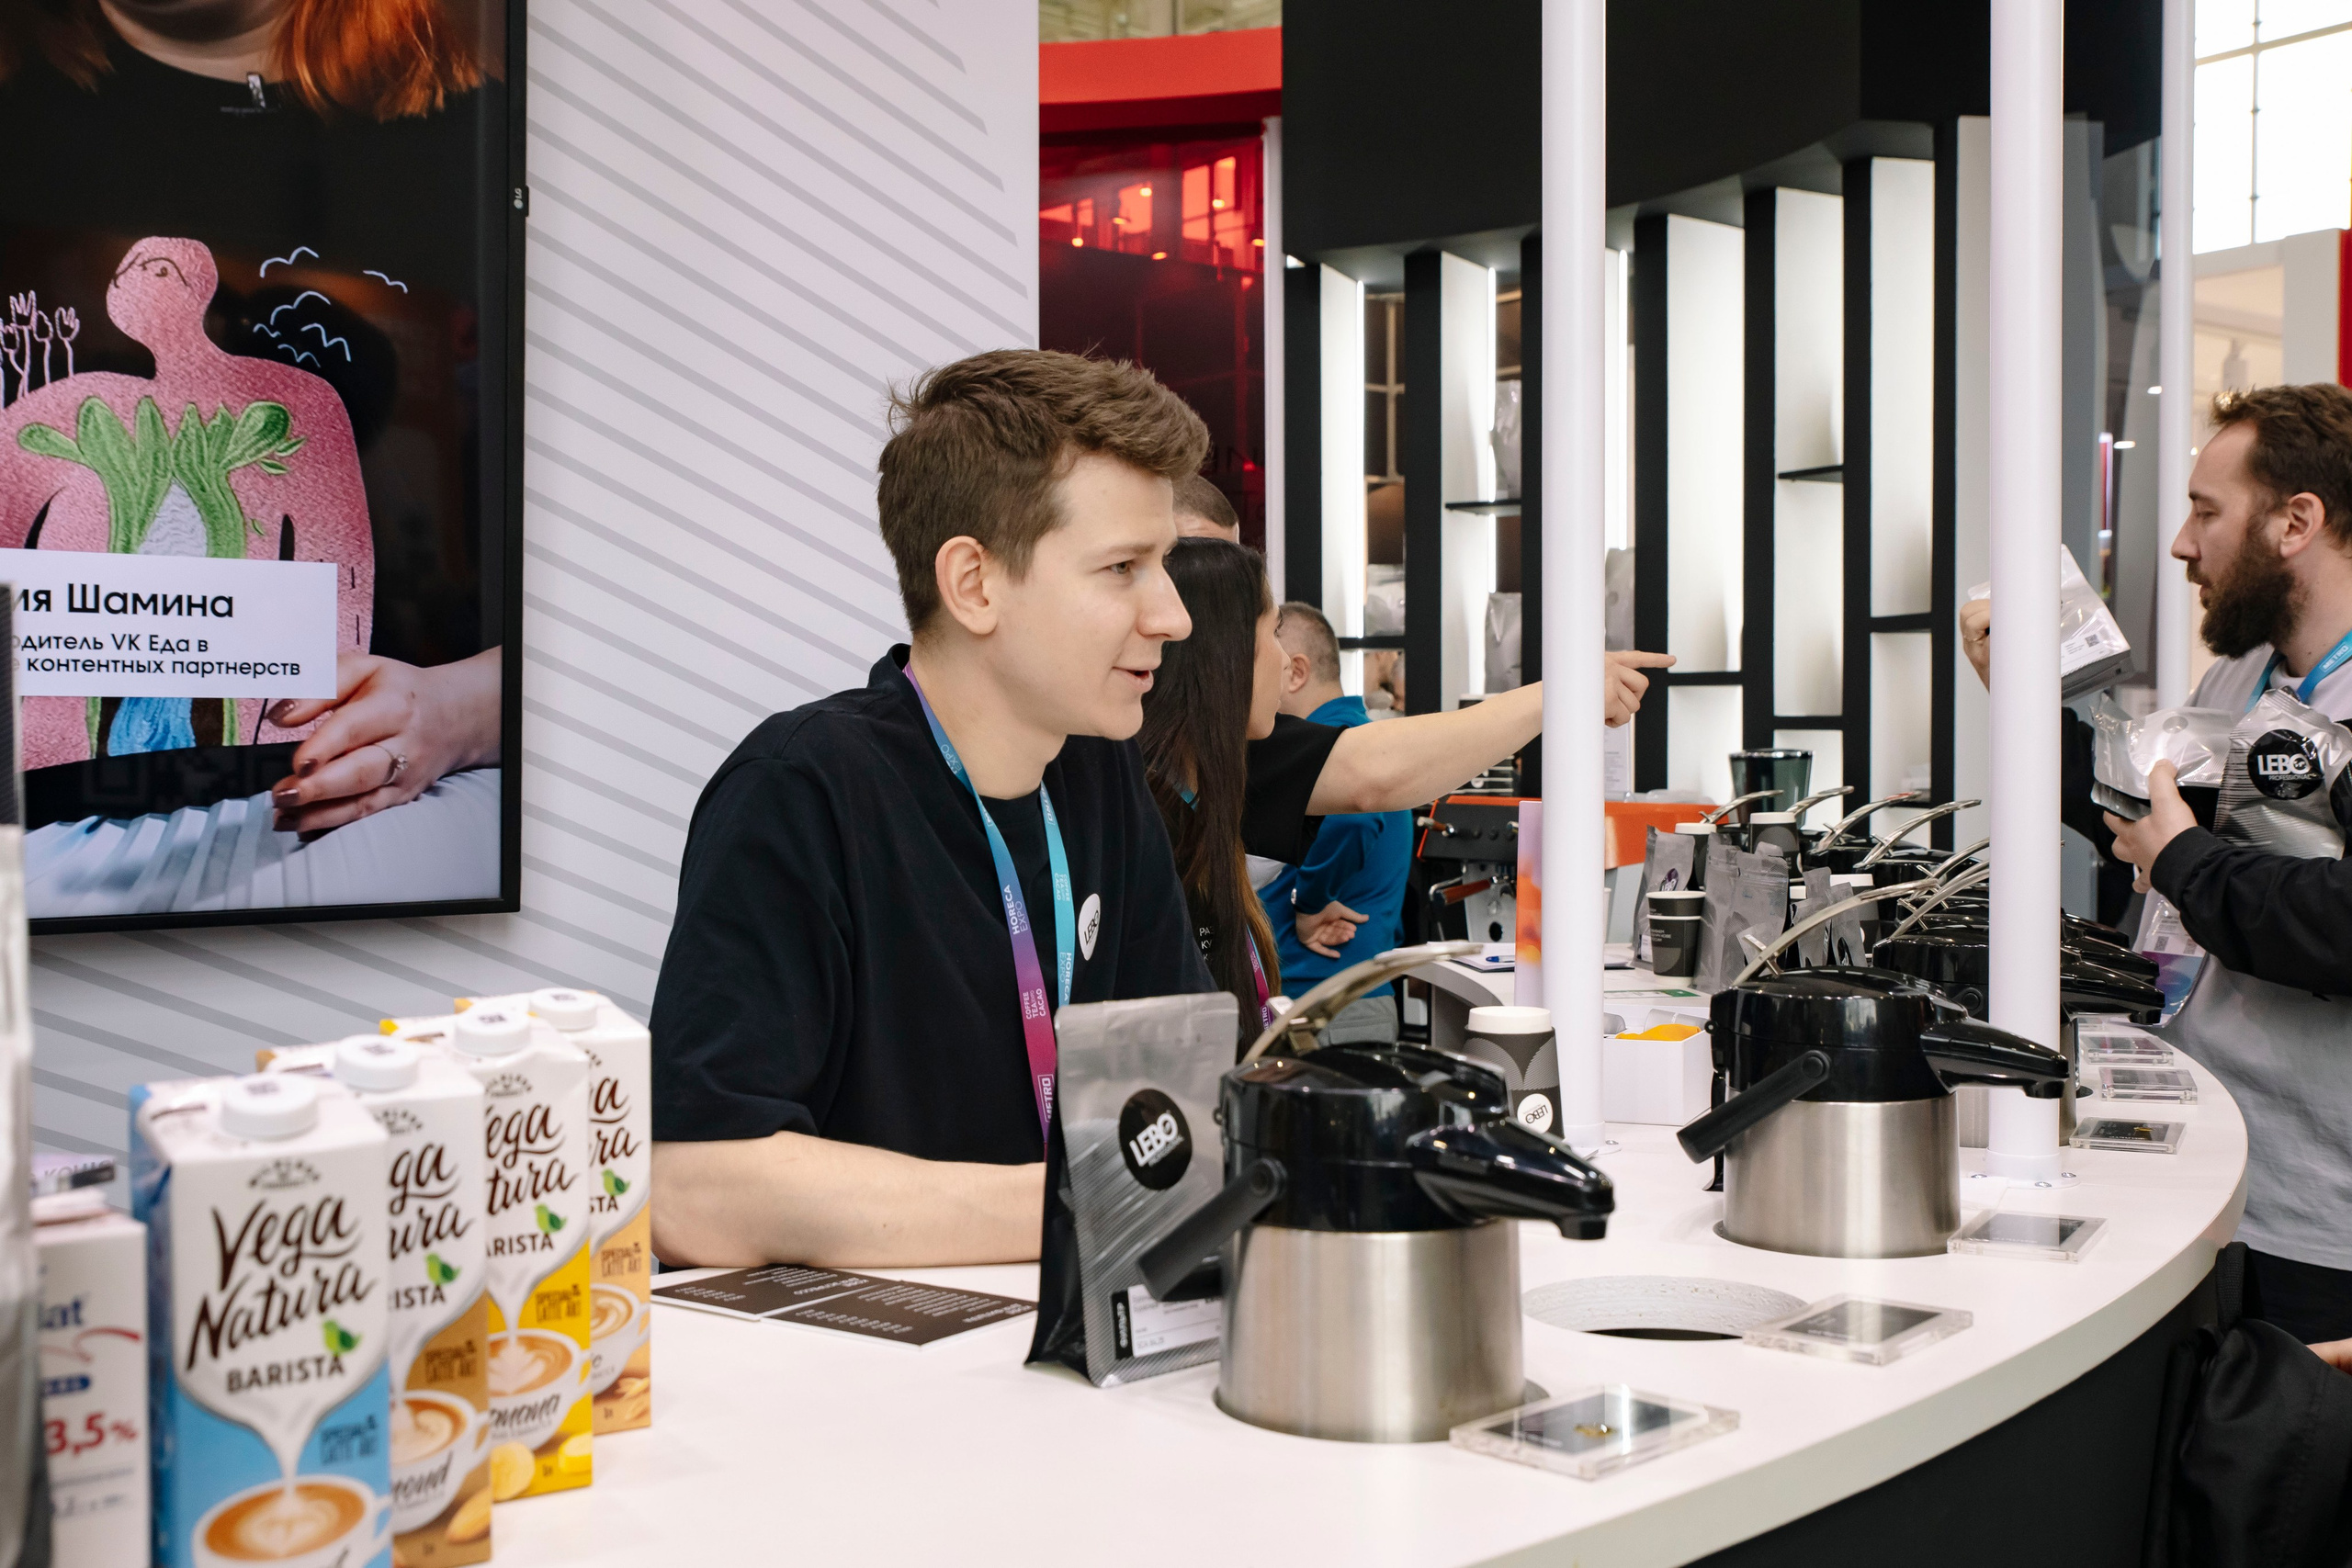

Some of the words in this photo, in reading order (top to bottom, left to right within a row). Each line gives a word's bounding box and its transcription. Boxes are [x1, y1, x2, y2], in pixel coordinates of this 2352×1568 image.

[514, 187, 523, 200] LG
[68, 582, 233, 618] Шамина
[111, 633, 141, 651] VK
[149, 635, 190, 654] Еда
[198, 639, 209, 653] в
[2322, 645, 2349, 670] METRO
[27, 658, 165, 674] контентных
[172, 660, 301, 680] партнерств
[2257, 753, 2311, 775] LEBO
[1003, 884, 1021, 935] HORECA
[1014, 900, 1028, 932] EXPO
[1083, 909, 1100, 945] LEBO
[1064, 952, 1072, 1001] HORECA
[1023, 991, 1032, 1020] COFFEE
[1035, 987, 1046, 1017] CACAO
[1525, 1104, 1549, 1124] LEBO
[486, 1103, 567, 1169] ega
[1128, 1112, 1178, 1168] LEBO
[210, 1196, 362, 1292] Vega
[186, 1261, 378, 1372] Natura
[226, 1355, 345, 1394] BARISTA
